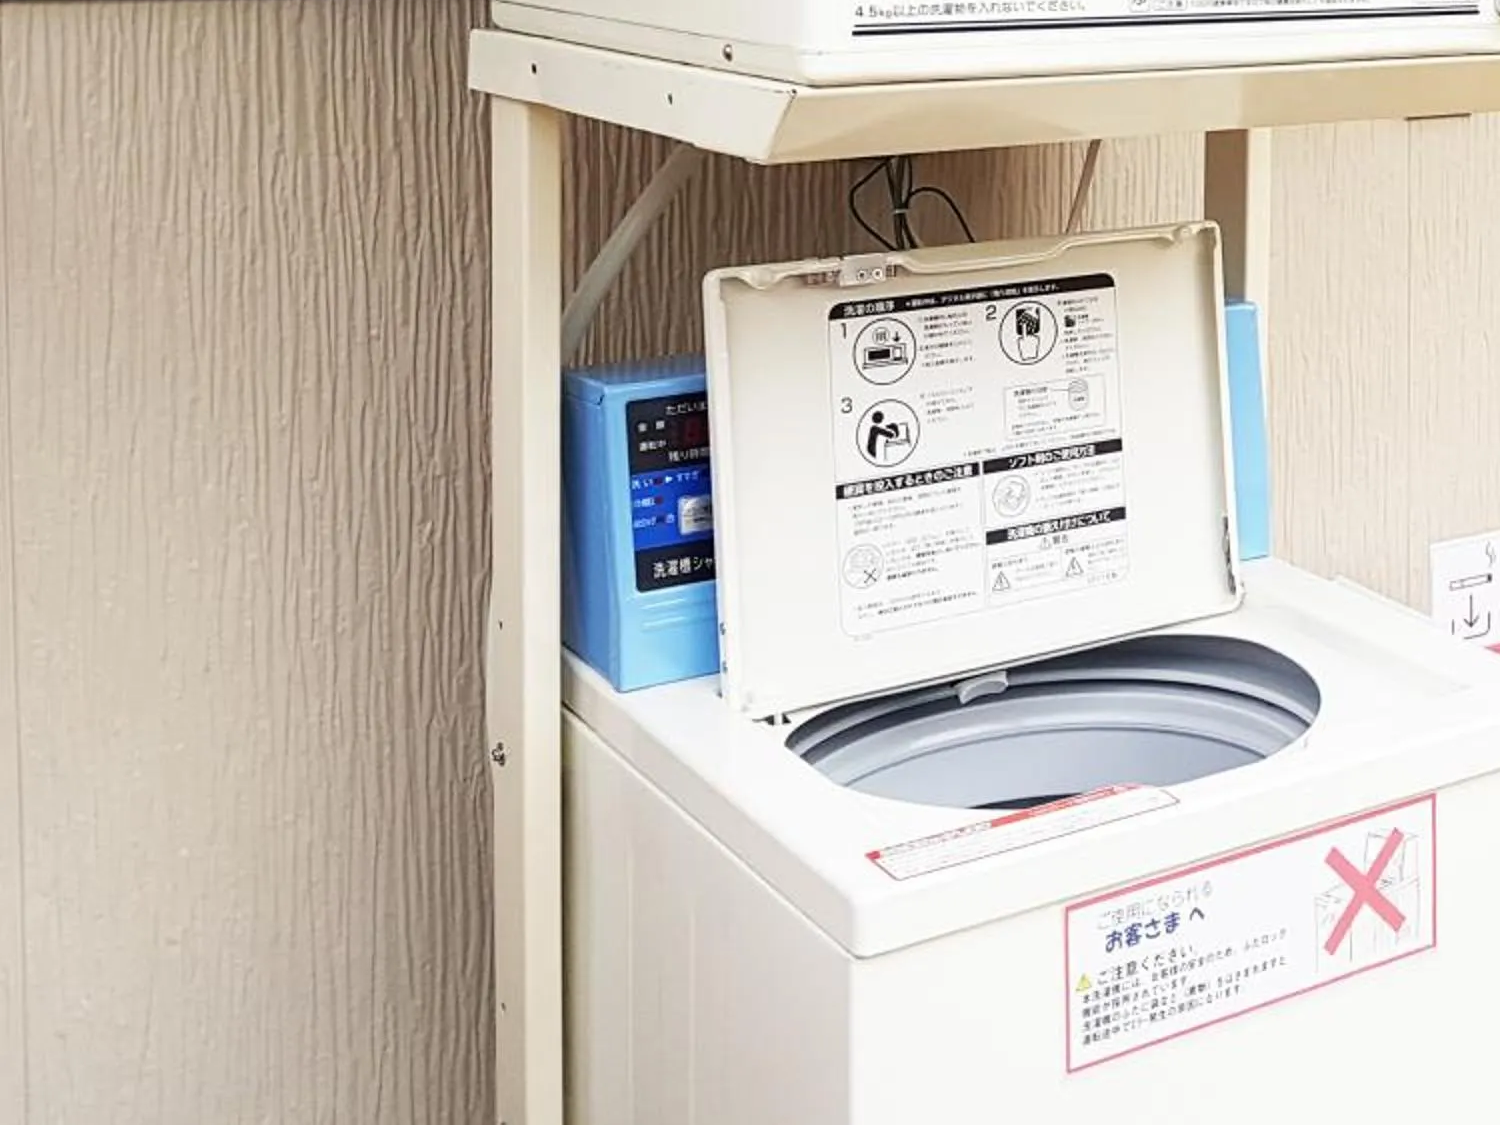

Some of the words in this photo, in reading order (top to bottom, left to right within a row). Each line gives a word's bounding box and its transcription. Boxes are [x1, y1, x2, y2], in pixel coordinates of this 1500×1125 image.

[985, 305, 998, 321] 2
[840, 323, 848, 339] 1
[840, 398, 853, 414] 3
[1097, 880, 1213, 930] ご使用になられる
